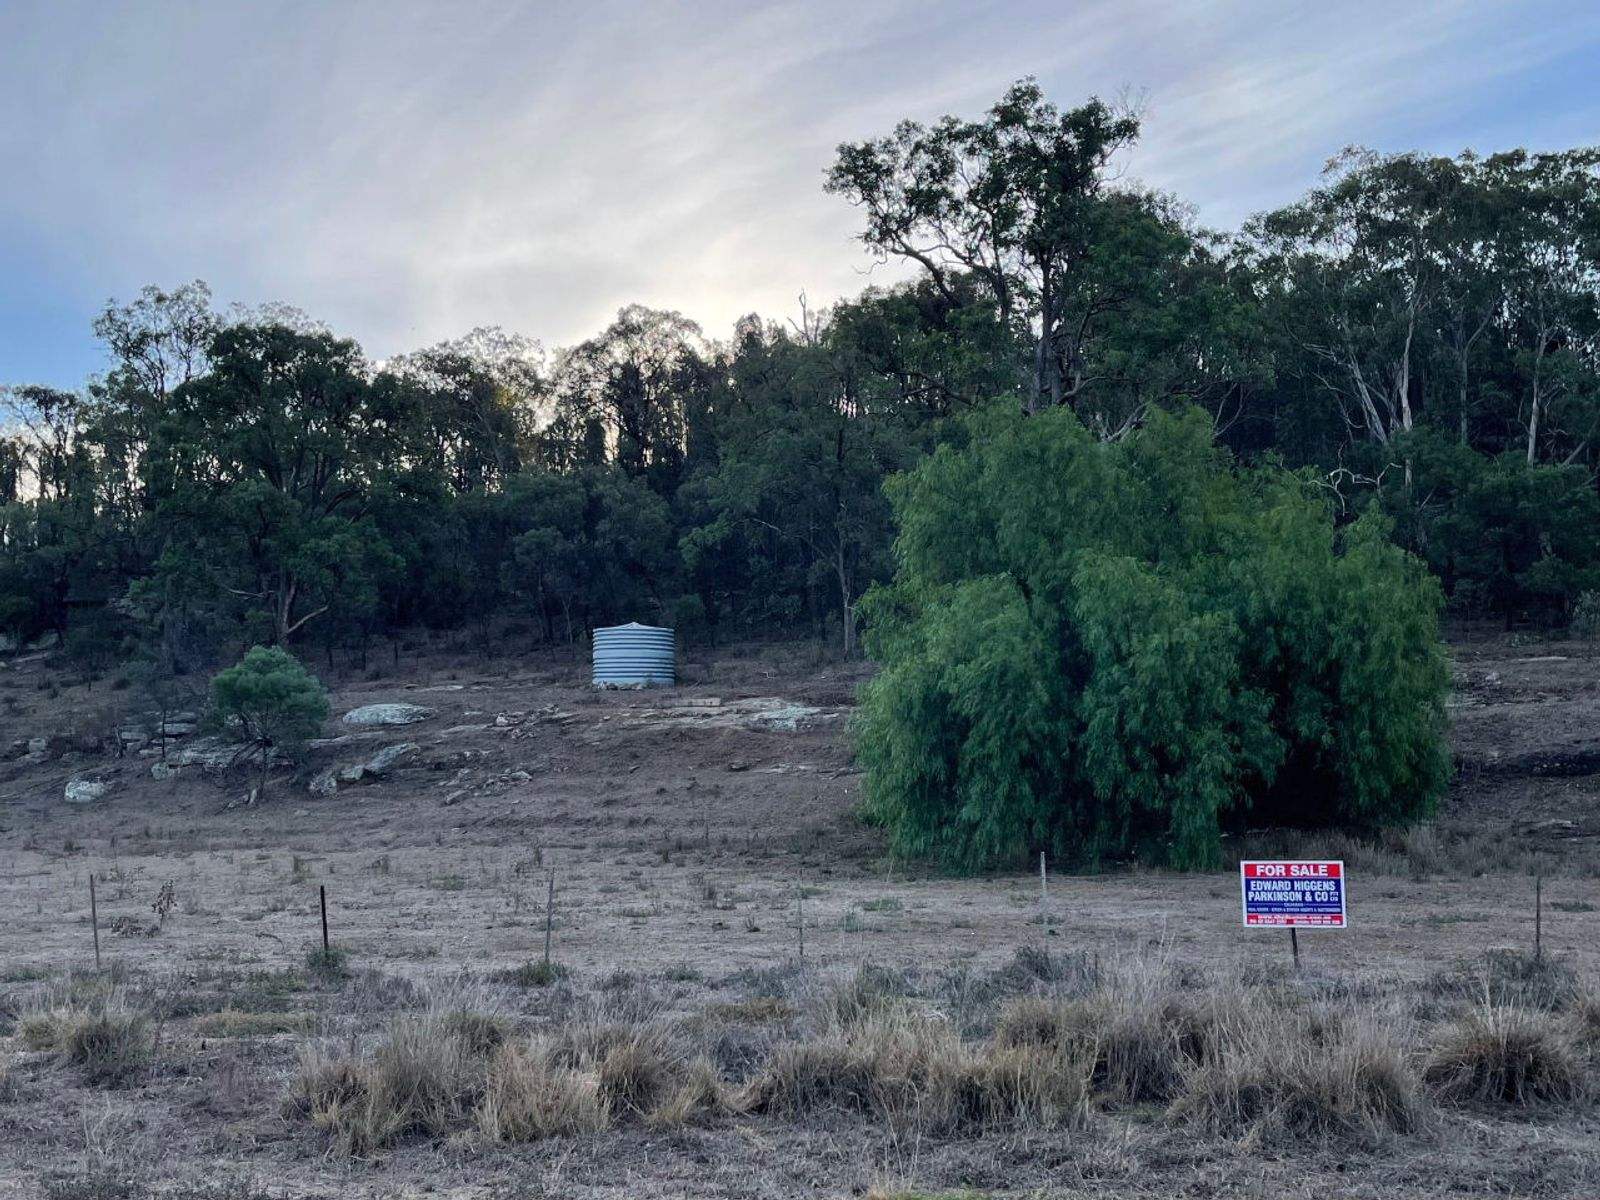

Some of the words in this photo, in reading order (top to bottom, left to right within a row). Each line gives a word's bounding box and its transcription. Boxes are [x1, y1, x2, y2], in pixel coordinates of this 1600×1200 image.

[1256, 865, 1286, 876] FOR
[1290, 865, 1329, 876] SALE
[1250, 880, 1292, 891] EDWARD
[1294, 880, 1336, 891] HIGGENS
[1248, 891, 1303, 901] PARKINSON
[1305, 892, 1312, 901] &
[1314, 891, 1328, 901] CO
